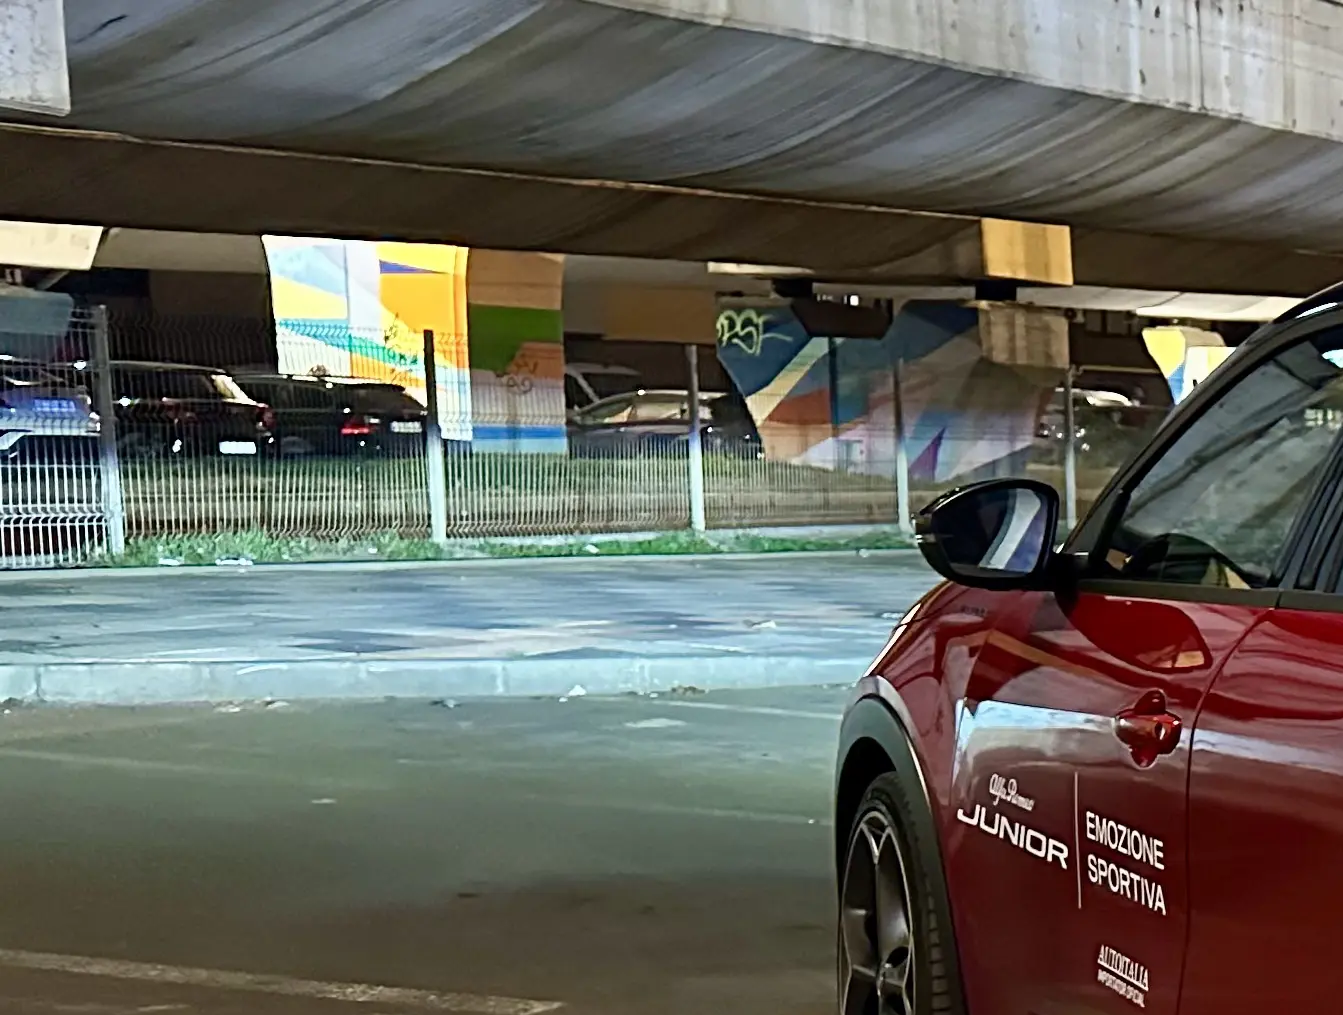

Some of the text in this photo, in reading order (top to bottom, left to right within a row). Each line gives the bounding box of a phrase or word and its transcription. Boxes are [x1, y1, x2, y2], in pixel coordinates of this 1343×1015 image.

[956, 803, 1069, 870] JUNIOR
[1085, 810, 1165, 871] EMOZIONE
[1087, 853, 1167, 916] SPORTIVA
[1097, 944, 1149, 989] AUTOITALIA
